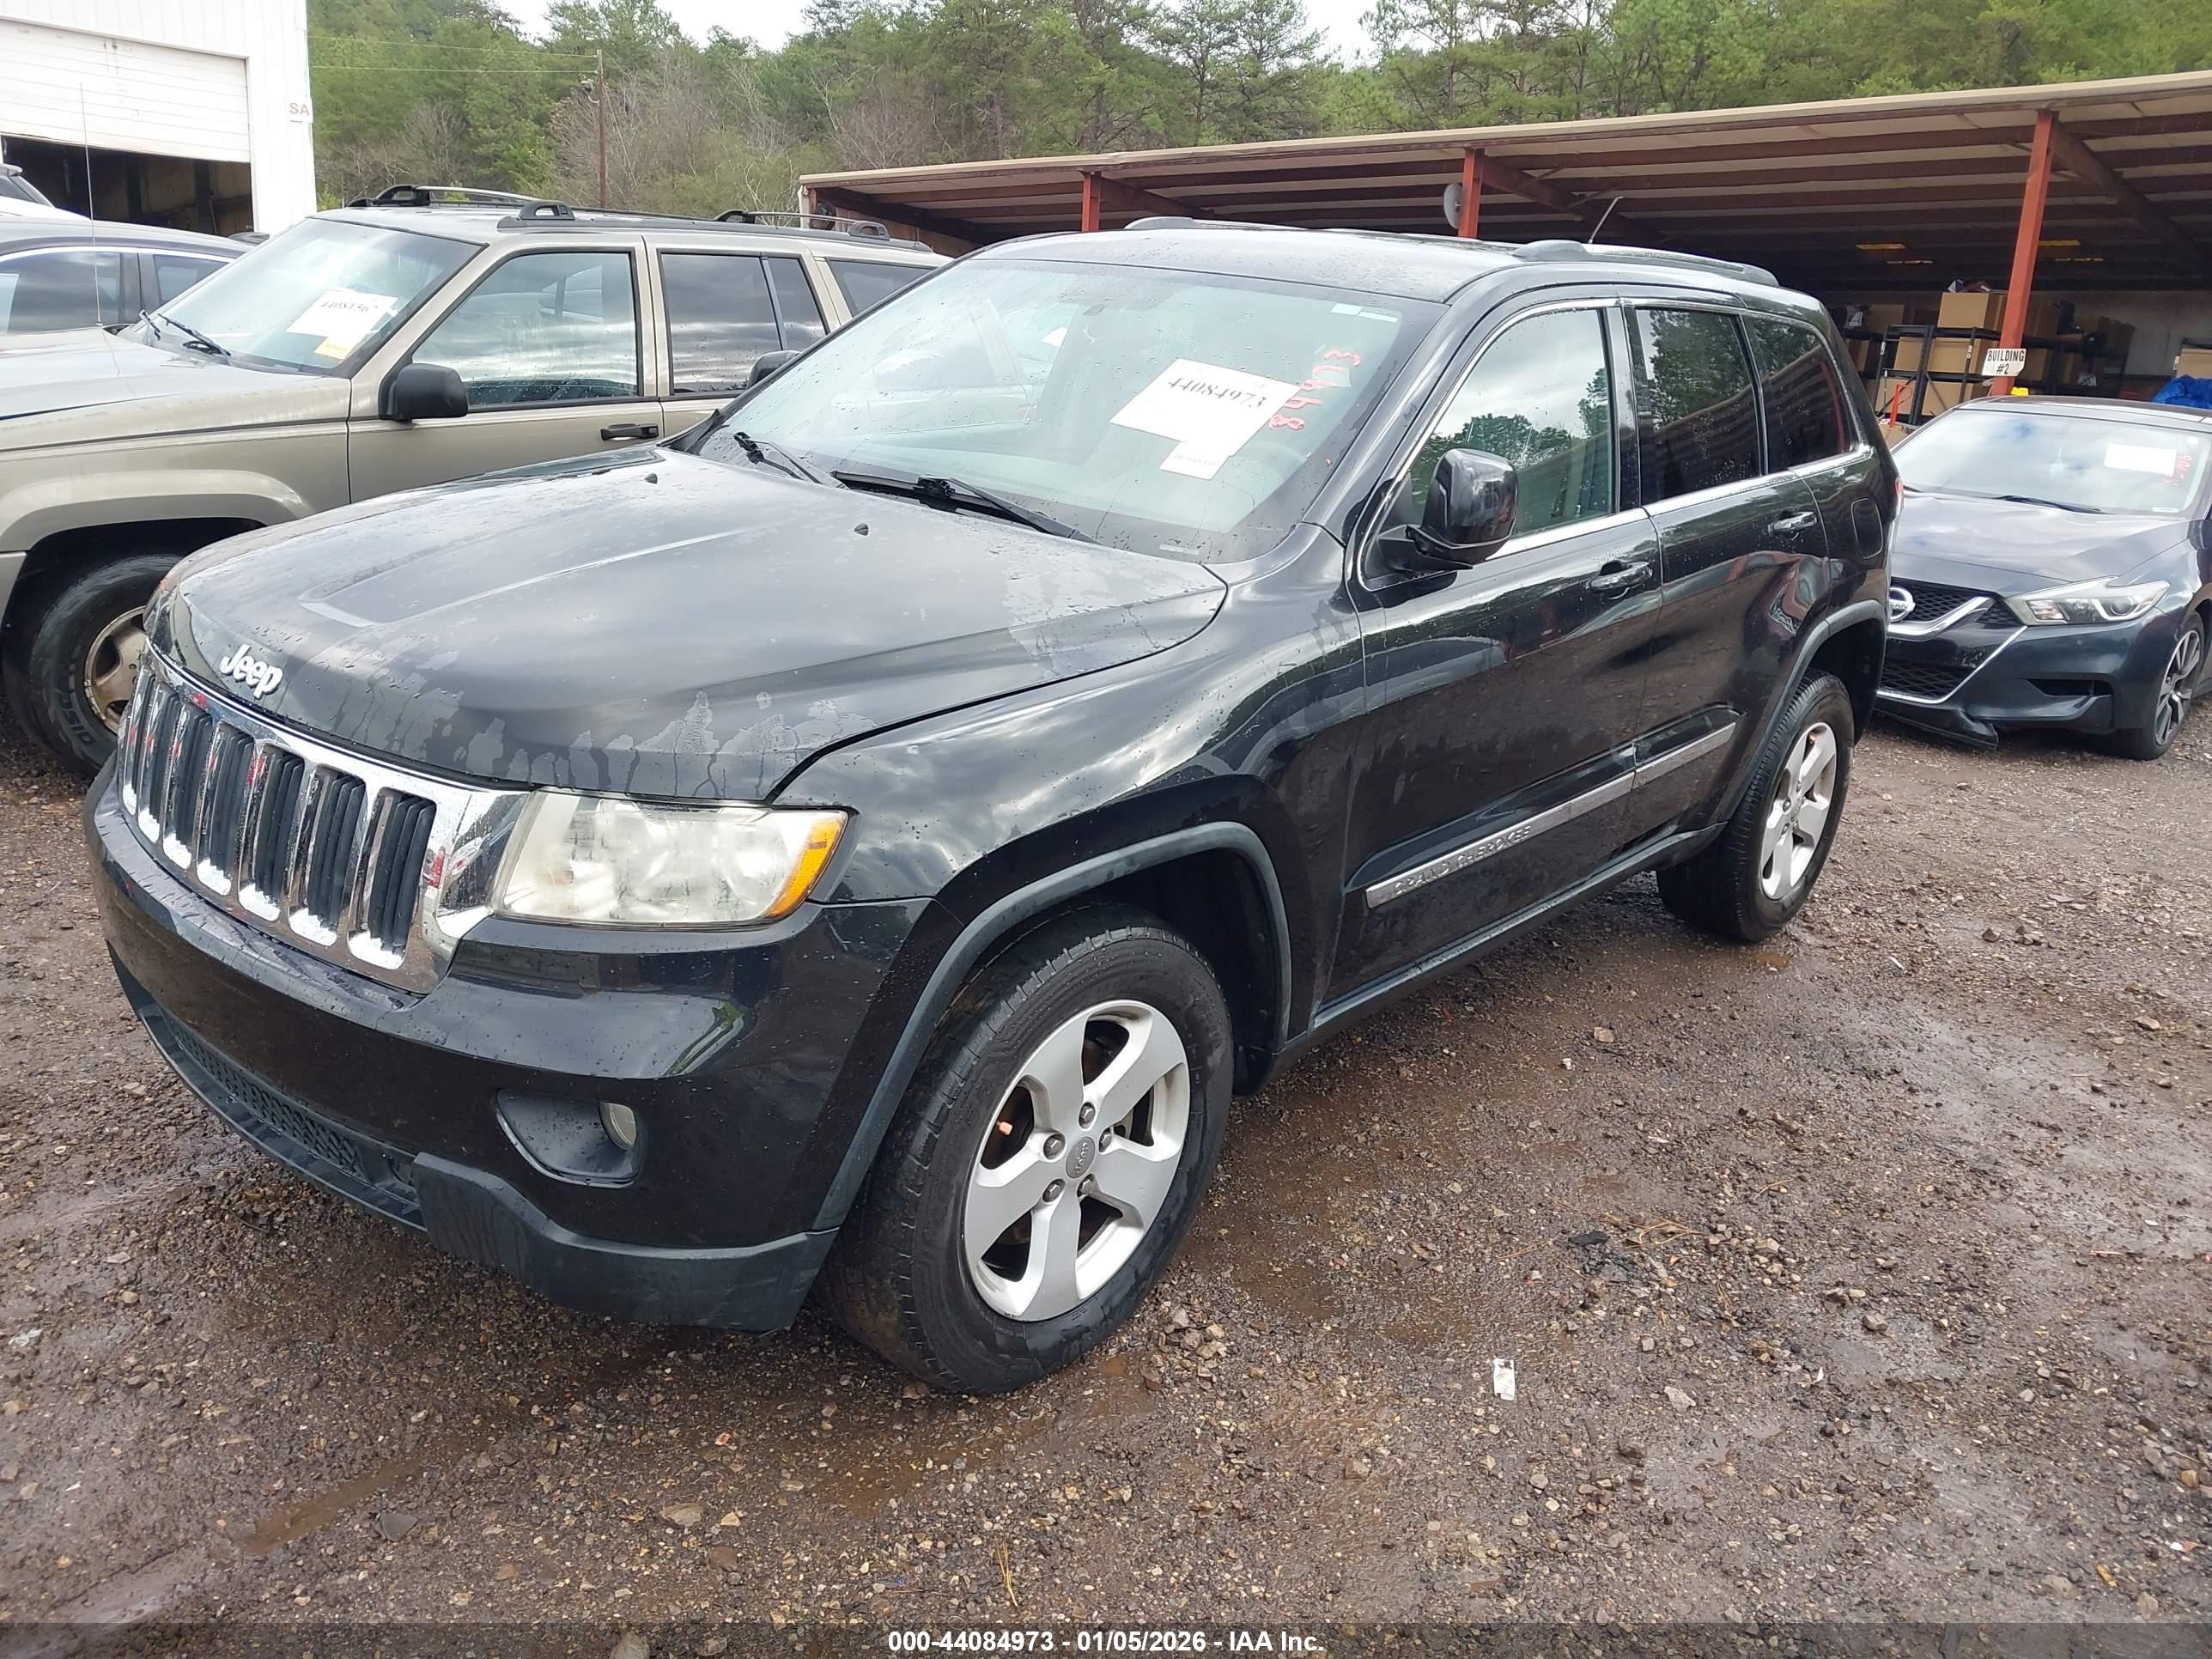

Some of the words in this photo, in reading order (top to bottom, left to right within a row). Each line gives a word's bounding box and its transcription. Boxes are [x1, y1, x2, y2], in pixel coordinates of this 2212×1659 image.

[1987, 349, 2025, 362] BUILDING
[1996, 362, 2009, 375] #2
[1168, 377, 1267, 407] 44084973
[219, 644, 283, 700] Jeep
[1394, 860, 1451, 896] GRAND
[1456, 824, 1532, 868] CHEROKEE
